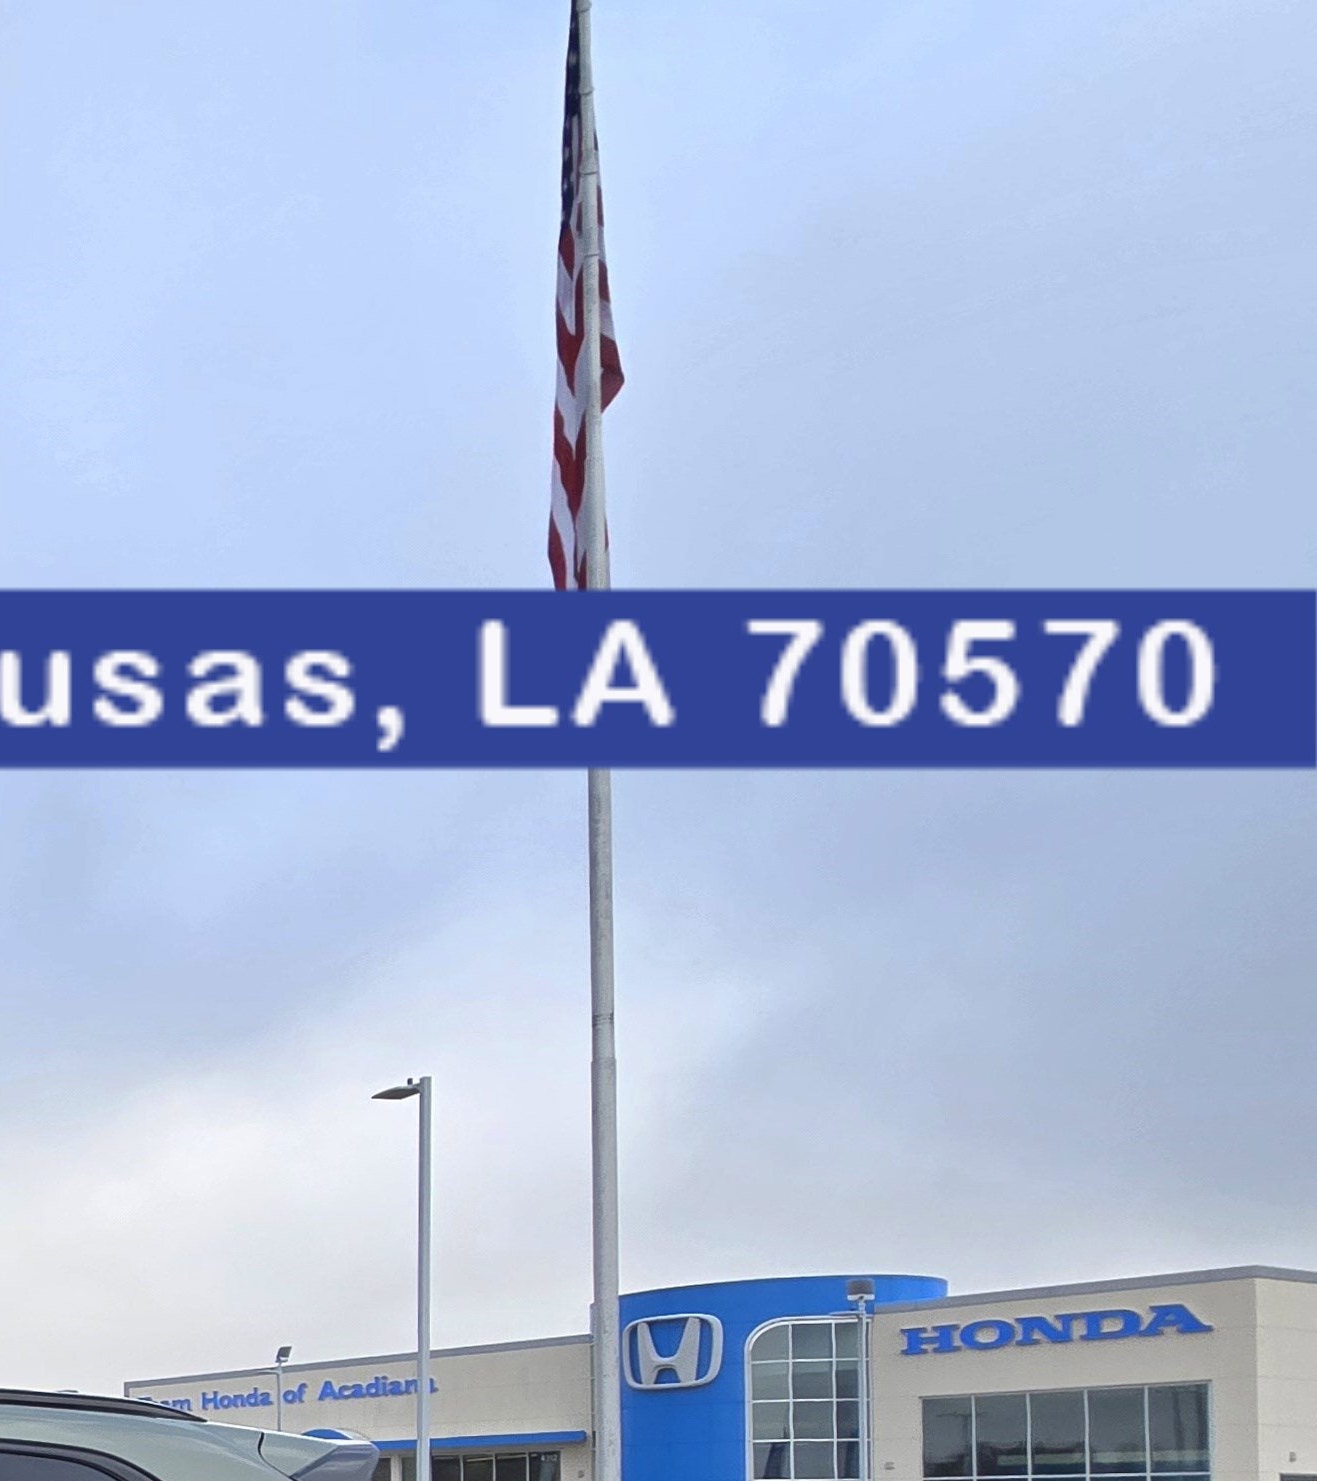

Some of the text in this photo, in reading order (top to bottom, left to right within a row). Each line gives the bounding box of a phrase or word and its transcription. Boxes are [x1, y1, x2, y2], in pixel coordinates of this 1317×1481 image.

[900, 1303, 1214, 1356] HONDA
[201, 1386, 275, 1411] Honda
[282, 1382, 308, 1404] of
